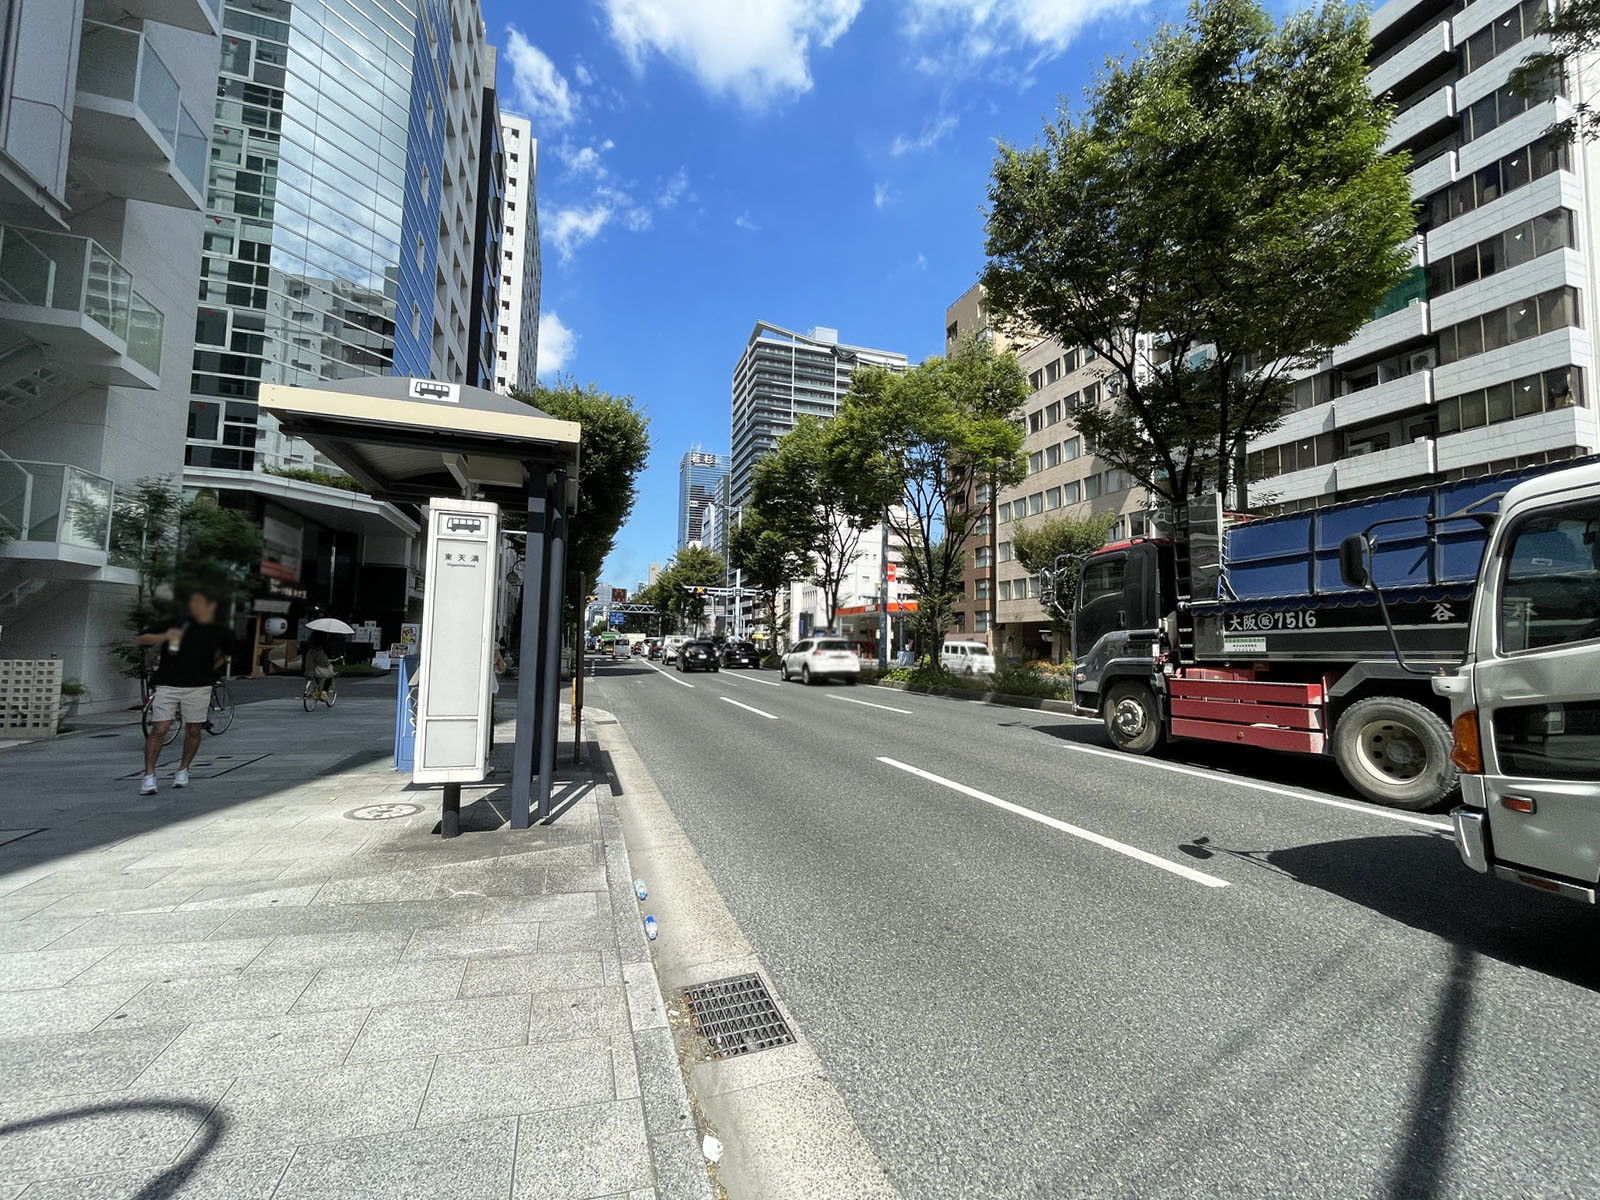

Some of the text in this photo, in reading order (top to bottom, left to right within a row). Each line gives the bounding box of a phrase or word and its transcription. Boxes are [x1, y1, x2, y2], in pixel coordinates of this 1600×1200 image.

[444, 553, 479, 562] 東天満
[1431, 603, 1455, 621] 谷
